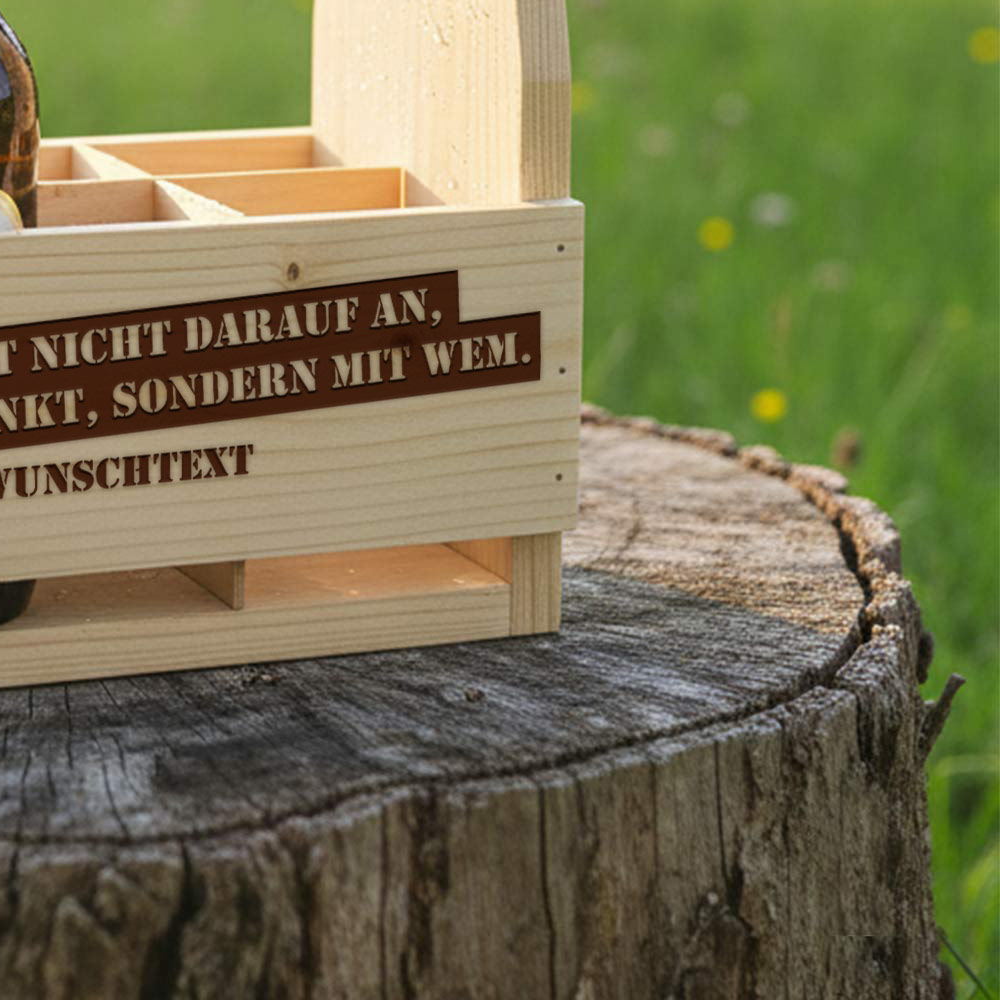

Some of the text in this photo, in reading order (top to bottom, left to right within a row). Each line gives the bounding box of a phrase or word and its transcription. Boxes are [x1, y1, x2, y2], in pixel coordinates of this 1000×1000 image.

[30, 320, 173, 372] NICHT
[184, 296, 360, 352] DARAUF
[371, 288, 443, 328] AN,
[112, 358, 318, 419] SONDERN
[331, 346, 411, 389] MIT
[422, 332, 532, 376] WEM.
